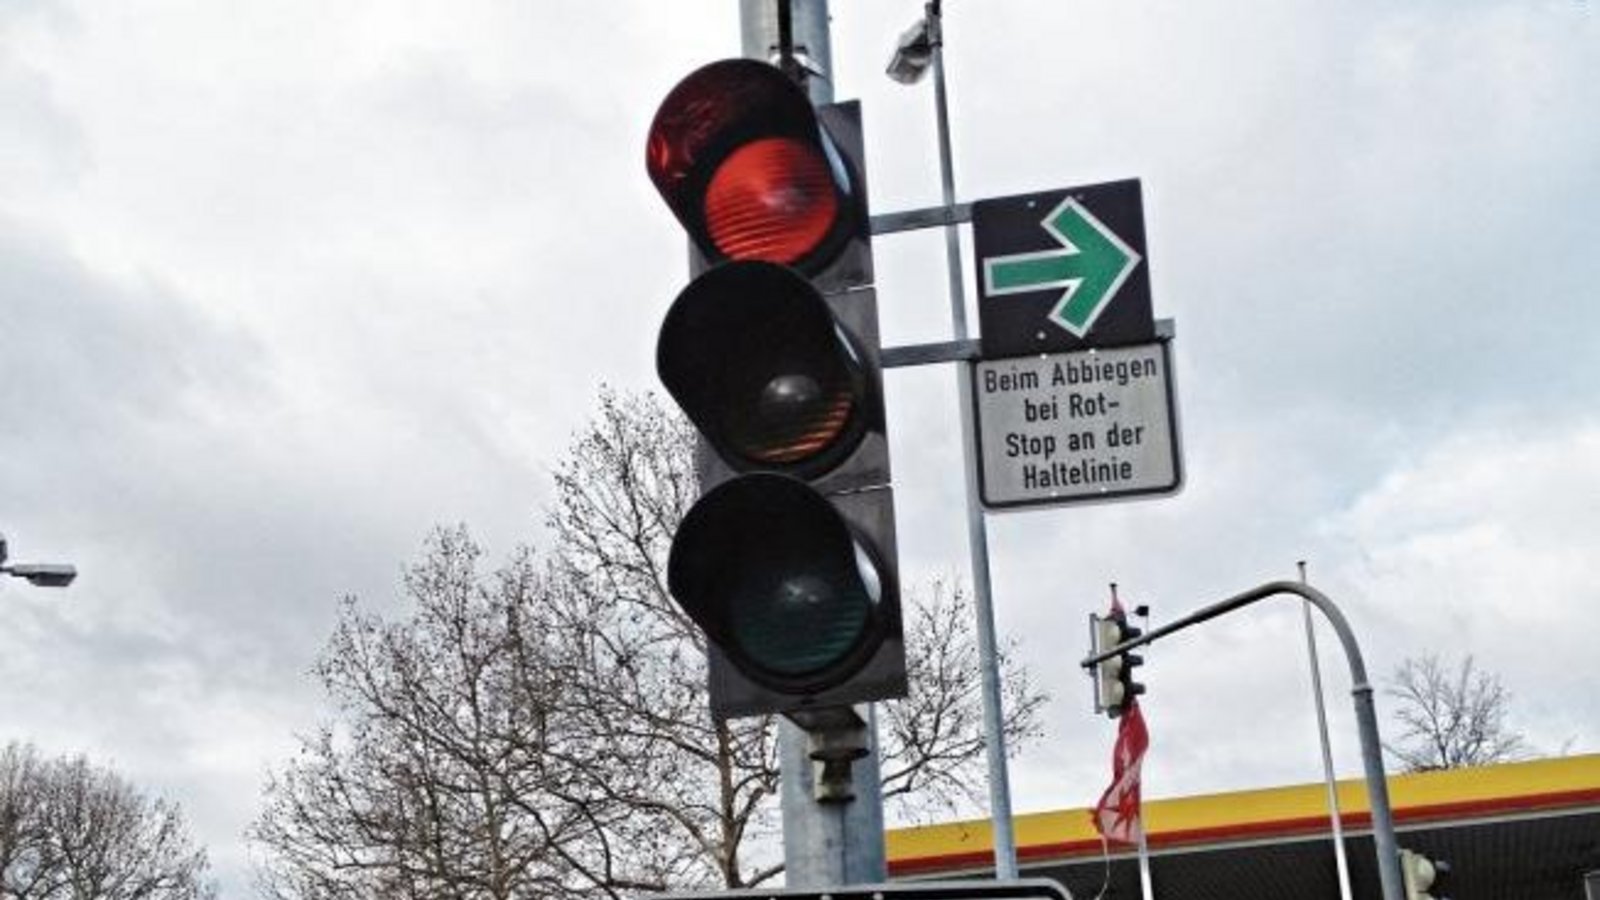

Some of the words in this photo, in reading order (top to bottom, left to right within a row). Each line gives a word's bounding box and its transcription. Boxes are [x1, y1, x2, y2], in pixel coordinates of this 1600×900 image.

[984, 365, 1039, 393] Beim
[1051, 357, 1157, 386] Abbiegen
[1024, 396, 1058, 422] bei
[1069, 392, 1120, 418] Rot-
[1006, 432, 1056, 460] Stop
[1068, 431, 1095, 452] an
[1107, 422, 1144, 448] der
[1023, 457, 1132, 489] Haltelinie
